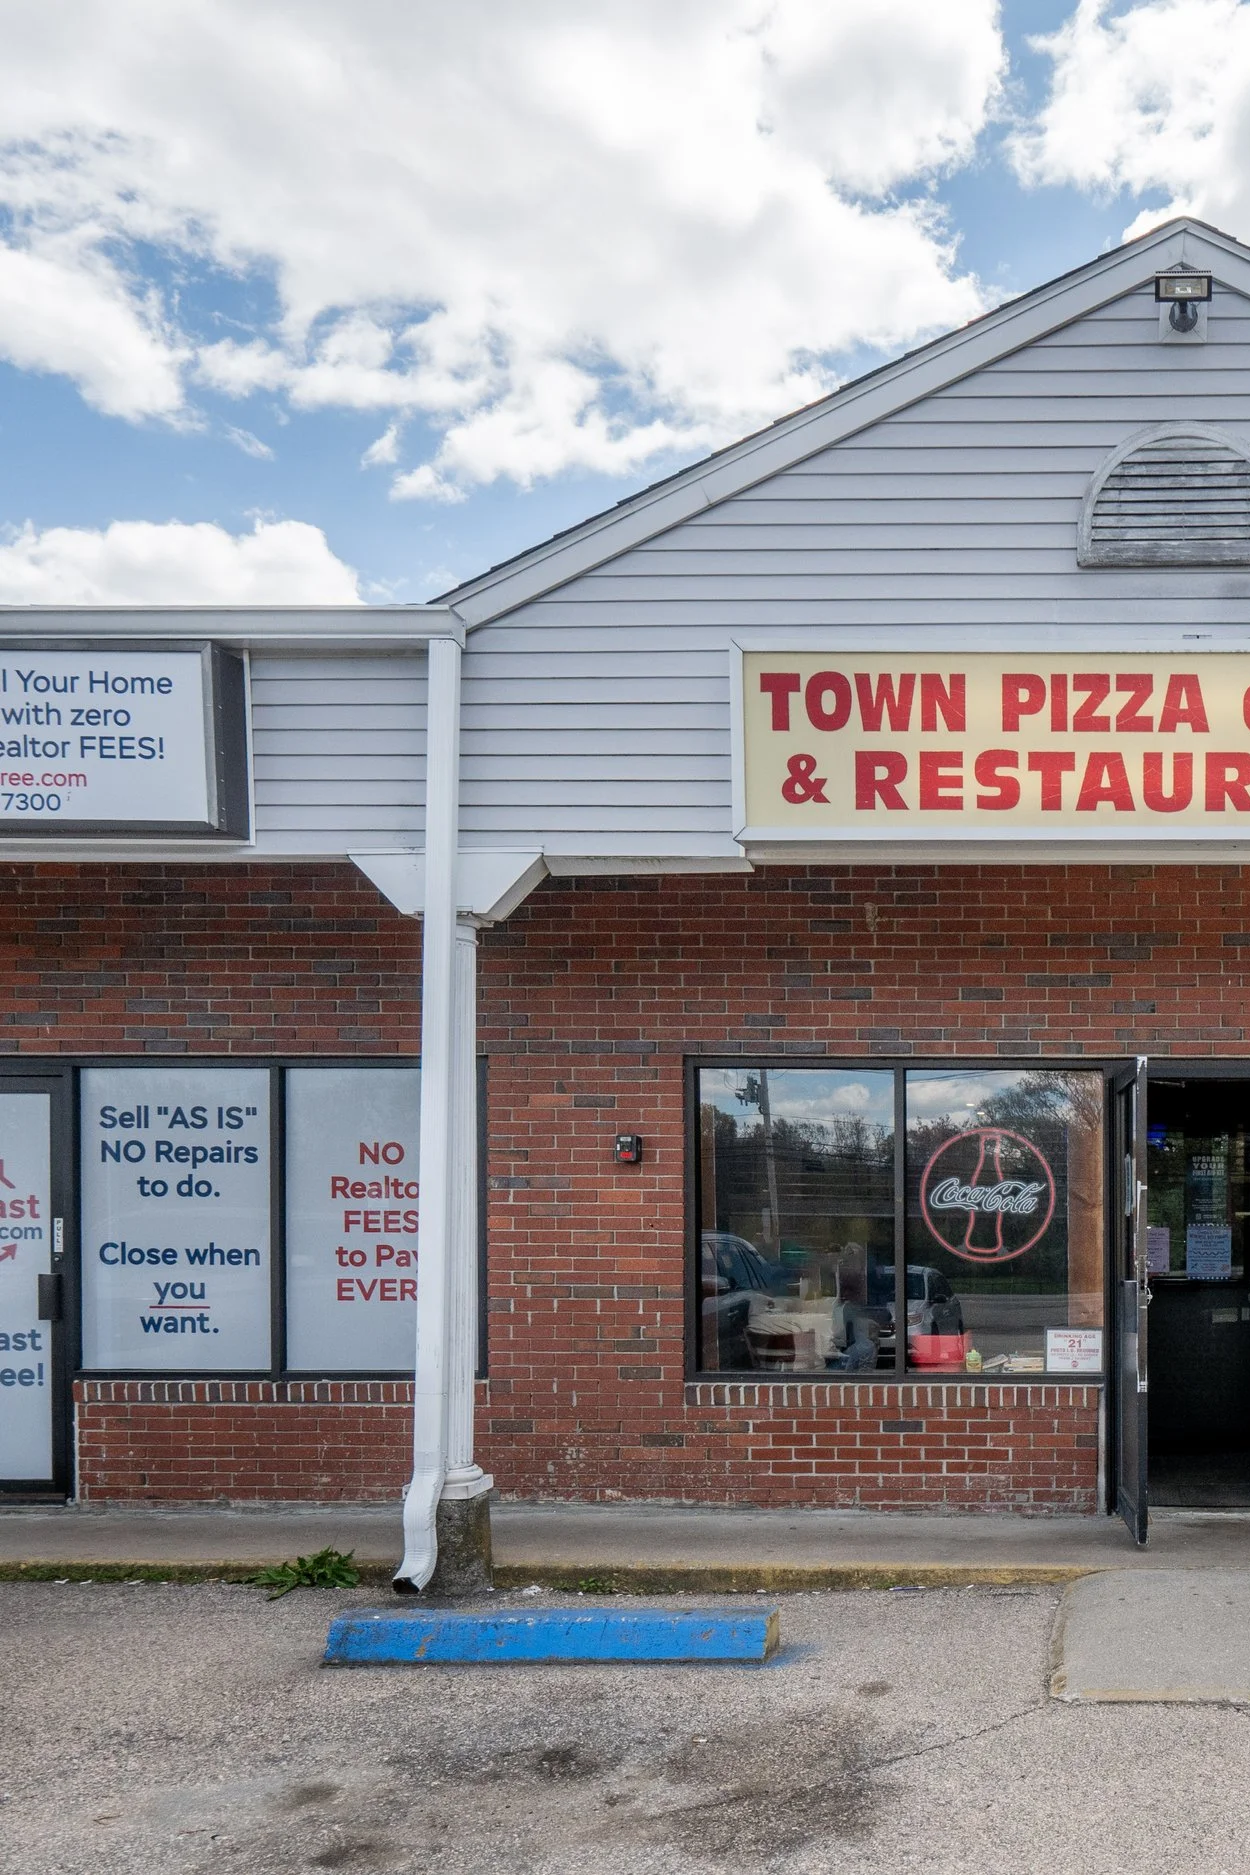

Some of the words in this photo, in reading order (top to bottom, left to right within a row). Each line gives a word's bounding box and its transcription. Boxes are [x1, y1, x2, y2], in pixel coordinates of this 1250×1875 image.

[15, 669, 80, 694] Your
[89, 670, 173, 695] Home
[1, 701, 62, 726] with
[70, 707, 131, 727] zero
[760, 671, 967, 733] TOWN
[1001, 673, 1210, 733] PIZZA
[80, 736, 164, 760] FEES!
[0, 772, 87, 787] ree.com
[781, 753, 831, 804] &
[1, 792, 62, 811] 7300
[99, 1105, 149, 1129] Sell
[157, 1105, 208, 1130] "AS
[217, 1106, 258, 1130] IS"
[101, 1140, 146, 1163] NO
[155, 1140, 259, 1169] Repairs
[359, 1142, 405, 1165] NO
[137, 1176, 169, 1198] to
[176, 1173, 221, 1198] do.
[344, 1209, 419, 1234] FEES
[99, 1241, 178, 1266] Close
[185, 1242, 261, 1266] when
[335, 1246, 367, 1267] to
[376, 1244, 418, 1273] Pa
[153, 1281, 206, 1305] you
[336, 1278, 418, 1301] EVER
[140, 1312, 220, 1334] want.
